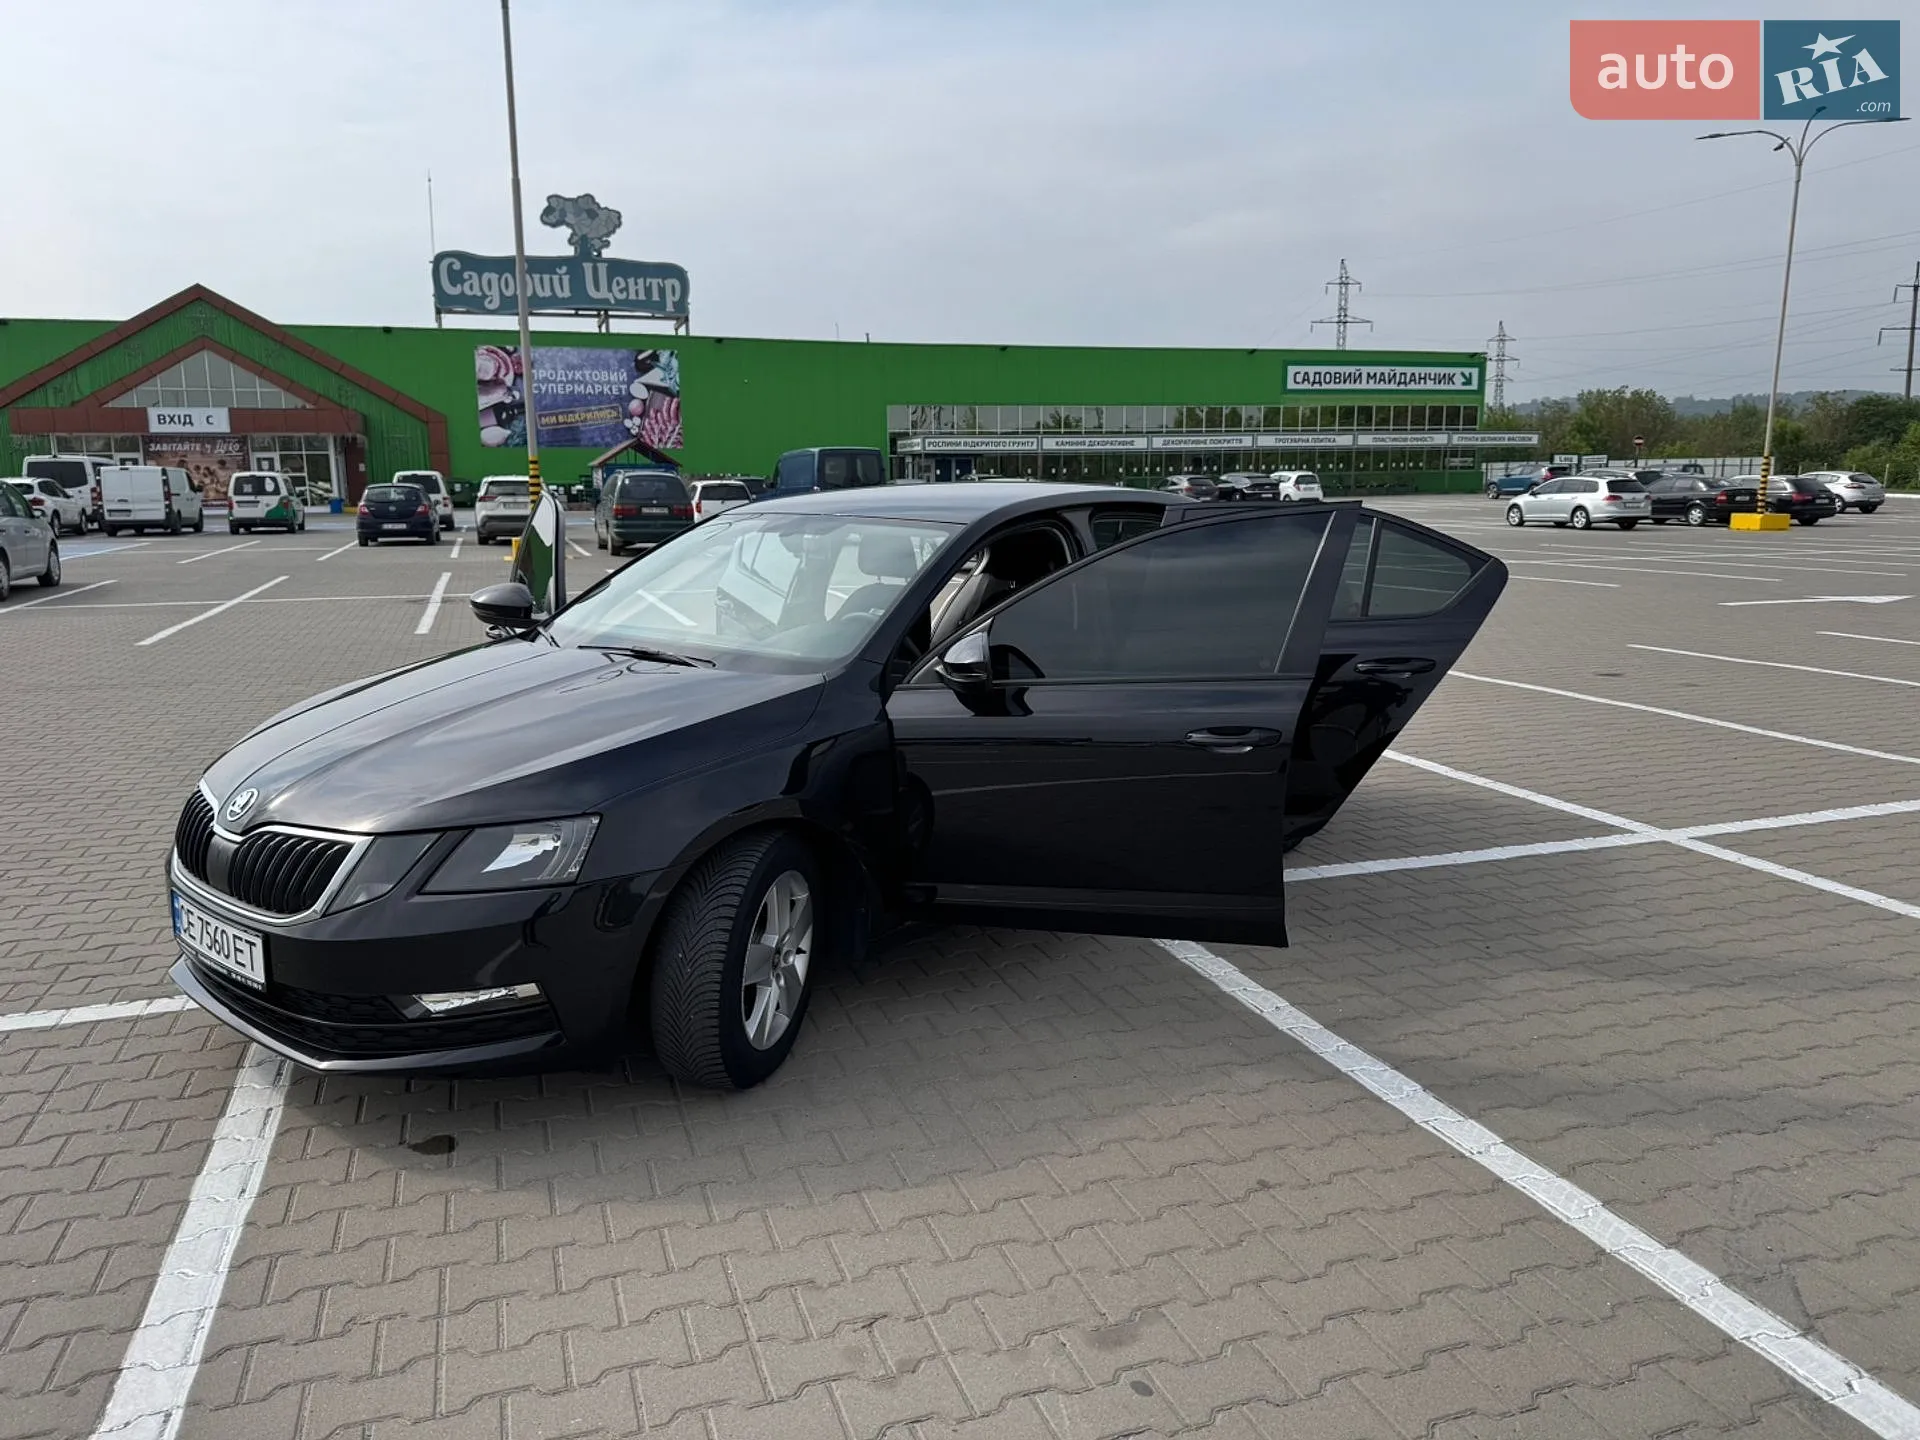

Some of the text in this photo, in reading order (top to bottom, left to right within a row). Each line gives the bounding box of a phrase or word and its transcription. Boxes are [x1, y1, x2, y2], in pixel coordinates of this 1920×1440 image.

[582, 262, 682, 312] Центр
[1293, 369, 1456, 387] САДОВИЙ МАЙДАНЧИК
[531, 383, 627, 395] СУПЕРМАРКЕТ
[157, 414, 194, 426] ВХІД
[541, 416, 557, 425] МИ
[148, 441, 201, 452] ЗАВІТАЙТЕ
